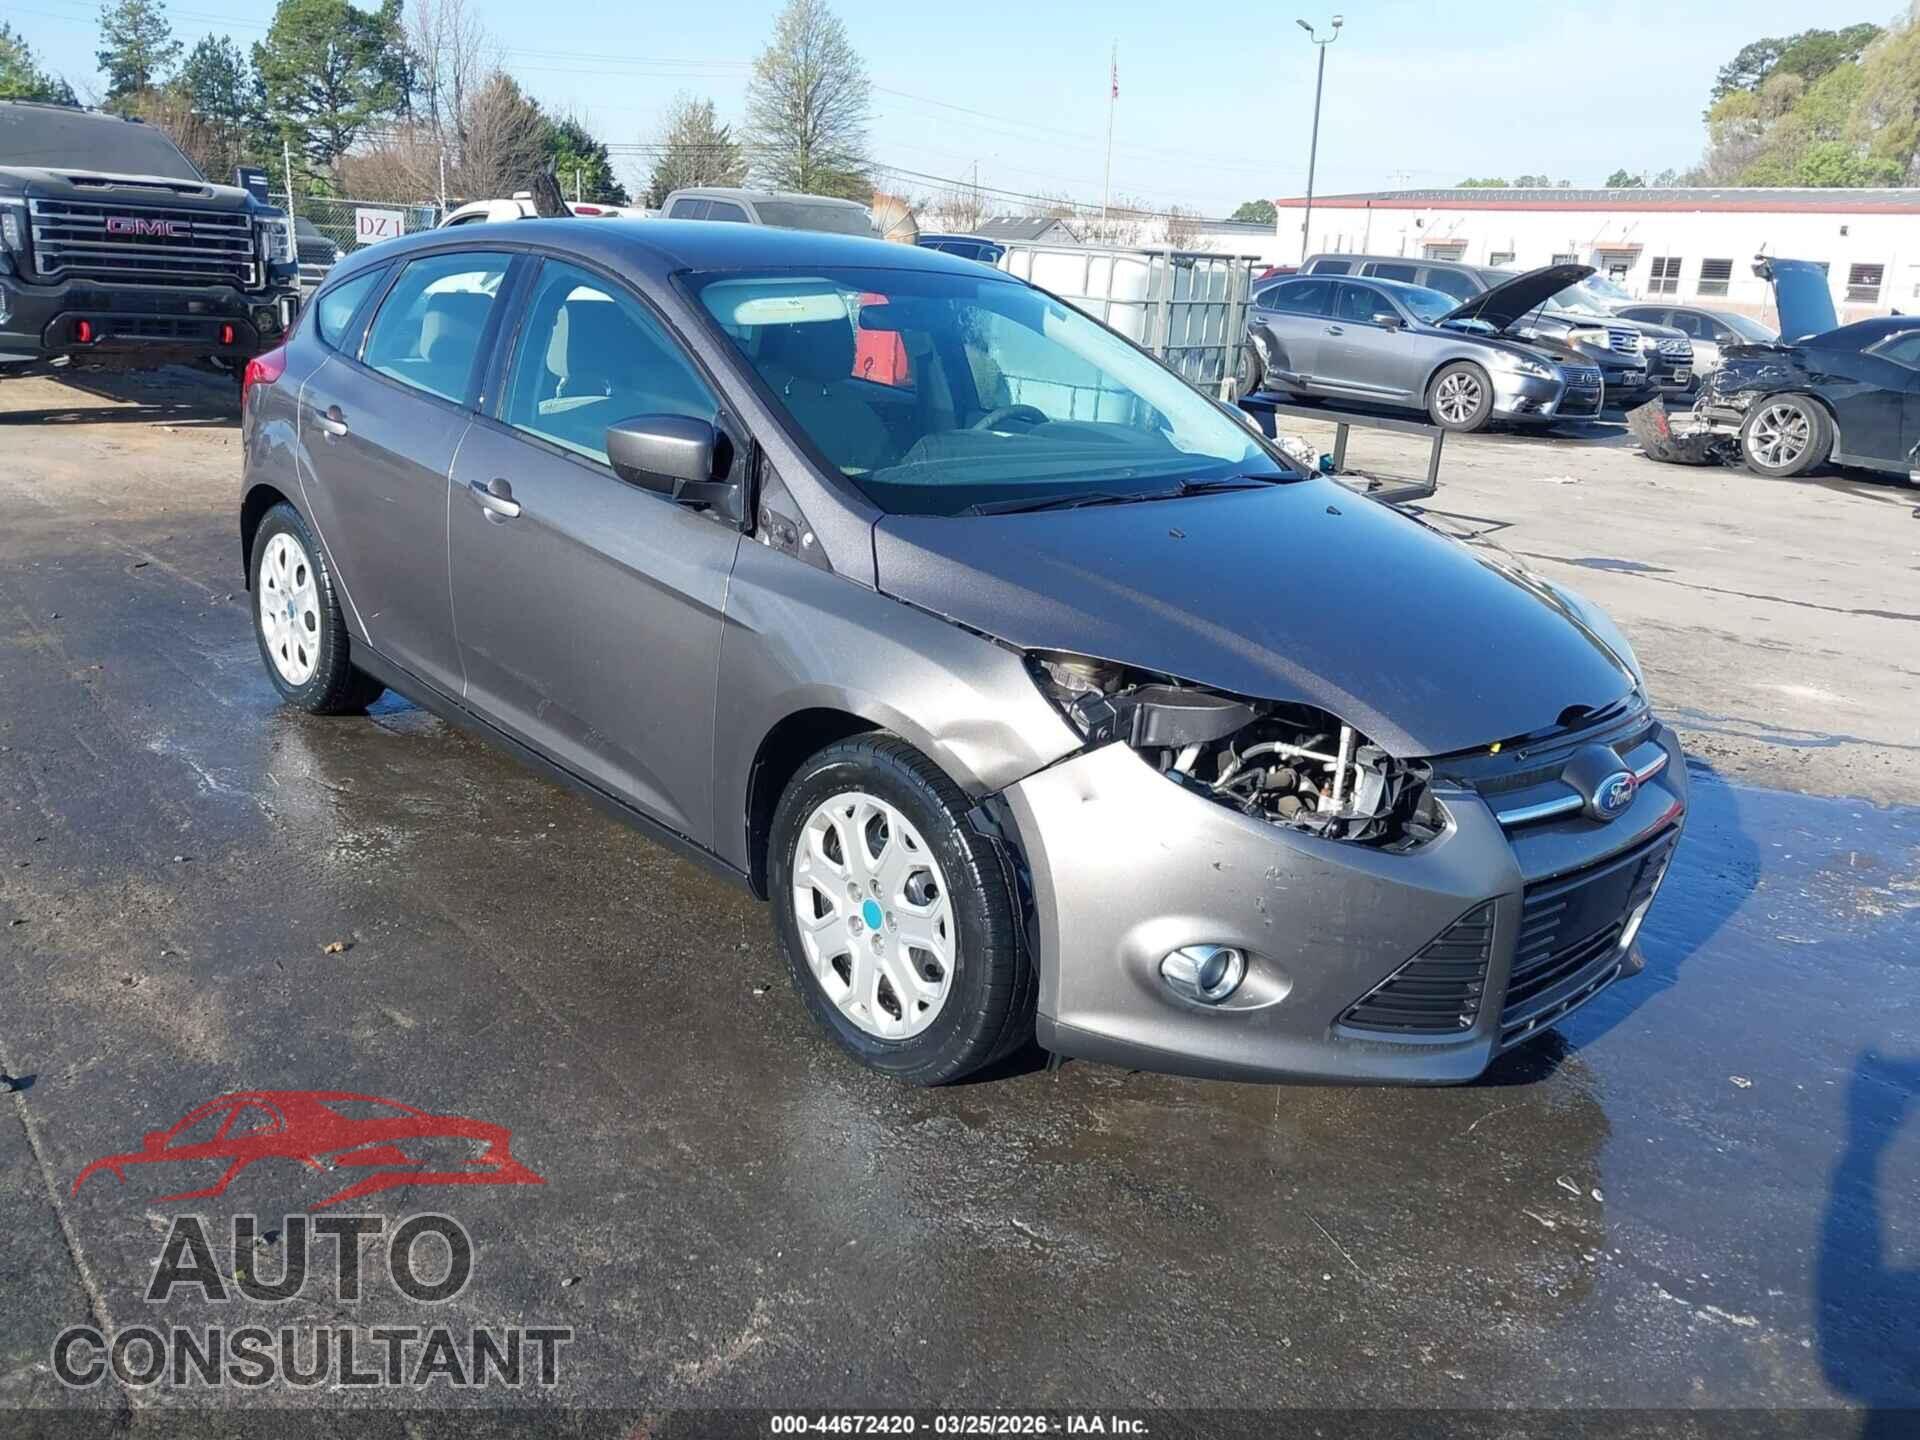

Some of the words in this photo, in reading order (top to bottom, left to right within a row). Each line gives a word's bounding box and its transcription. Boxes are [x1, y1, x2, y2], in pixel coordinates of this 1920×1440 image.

[107, 215, 192, 238] GMC
[360, 216, 388, 237] DZ
[1609, 782, 1633, 808] Ford
